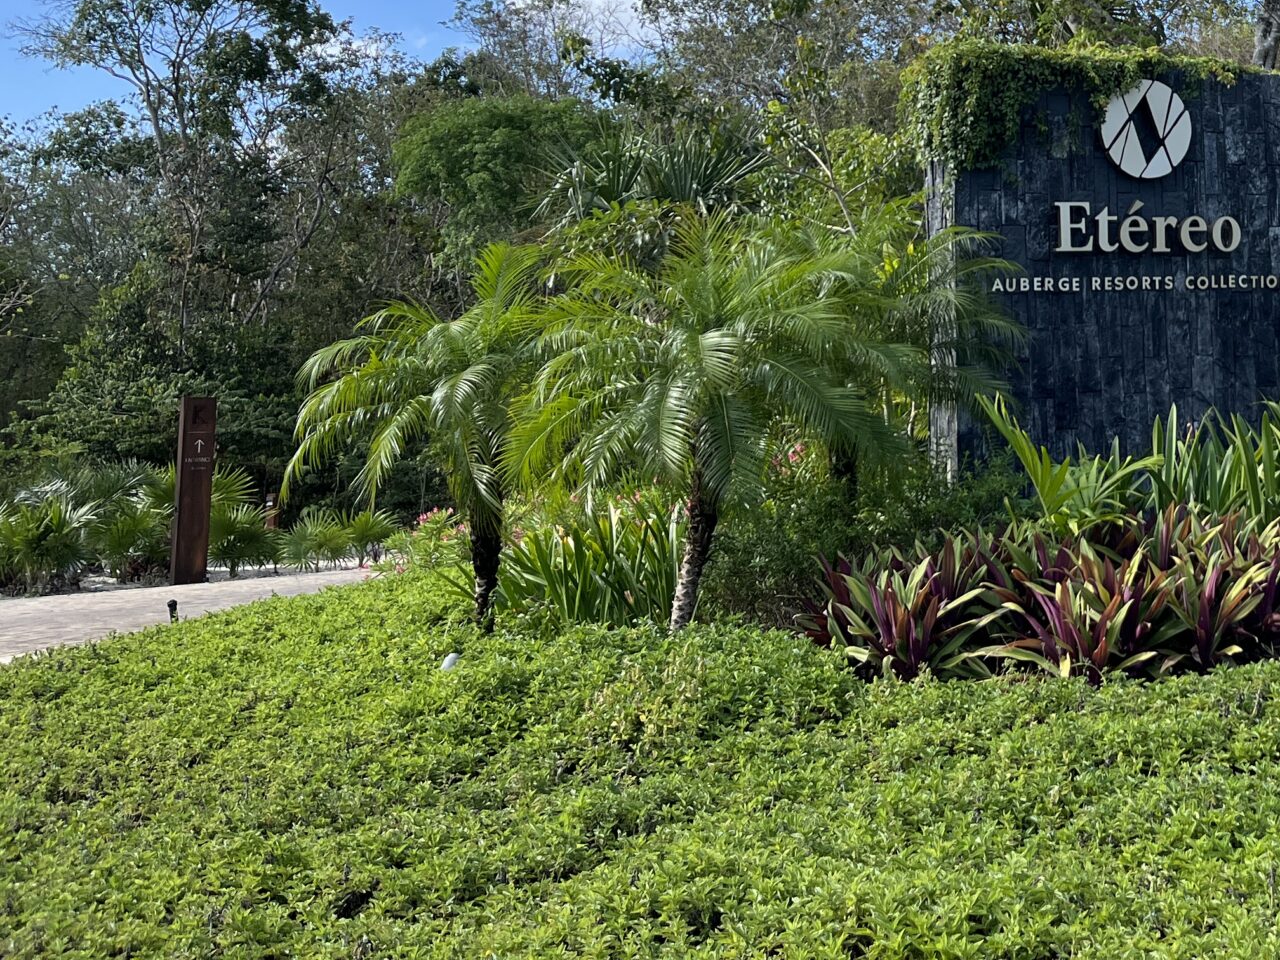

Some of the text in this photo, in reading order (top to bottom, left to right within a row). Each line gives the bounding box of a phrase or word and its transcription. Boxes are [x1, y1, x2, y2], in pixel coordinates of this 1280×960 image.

[1054, 199, 1242, 254] Etéreo
[992, 276, 1080, 292] AUBERGE
[1091, 275, 1173, 291] RESORTS
